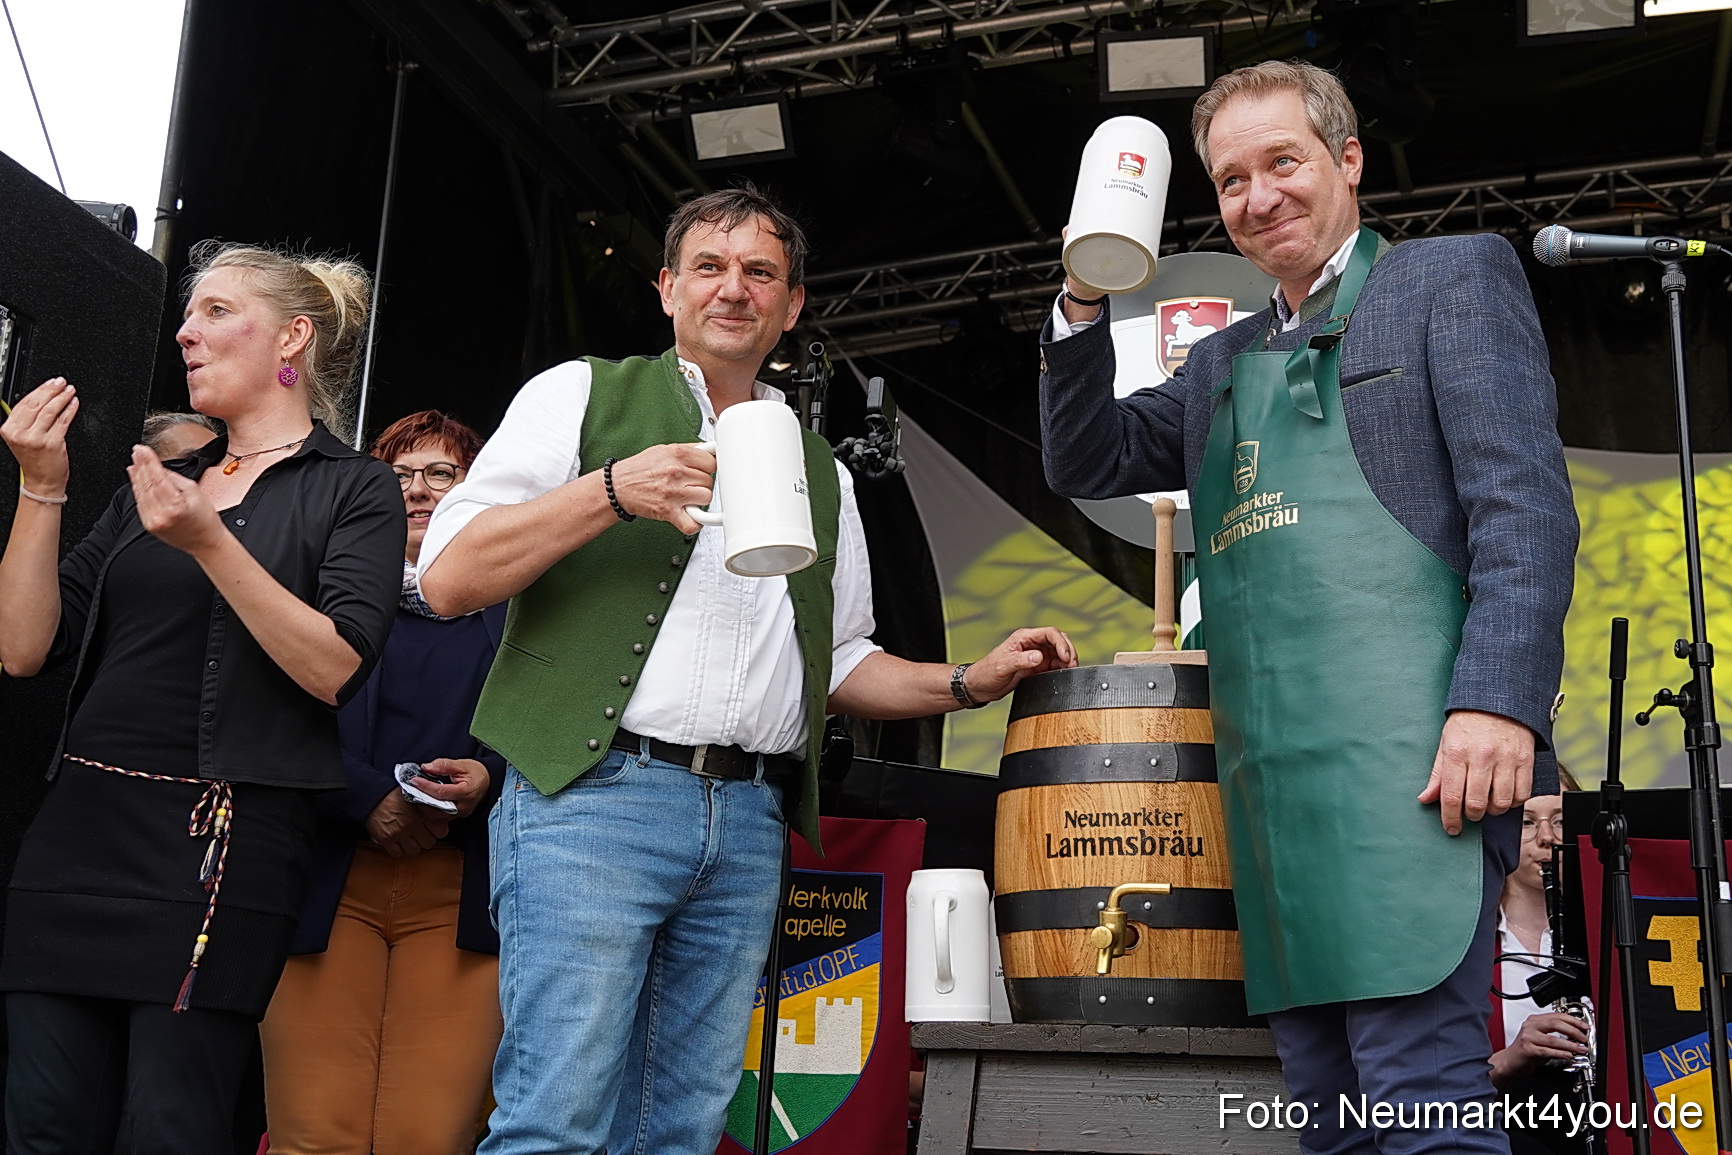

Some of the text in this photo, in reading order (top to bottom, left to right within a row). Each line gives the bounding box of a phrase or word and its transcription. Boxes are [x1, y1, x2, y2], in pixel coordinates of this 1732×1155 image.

[1104, 182, 1148, 199] Lammsbräu
[1221, 491, 1284, 528] Neumarkter
[1210, 504, 1299, 555] Lammsbräu
[1064, 807, 1184, 829] Neumarkter
[1046, 829, 1205, 859] Lammsbräu
[784, 914, 847, 942] apelle
